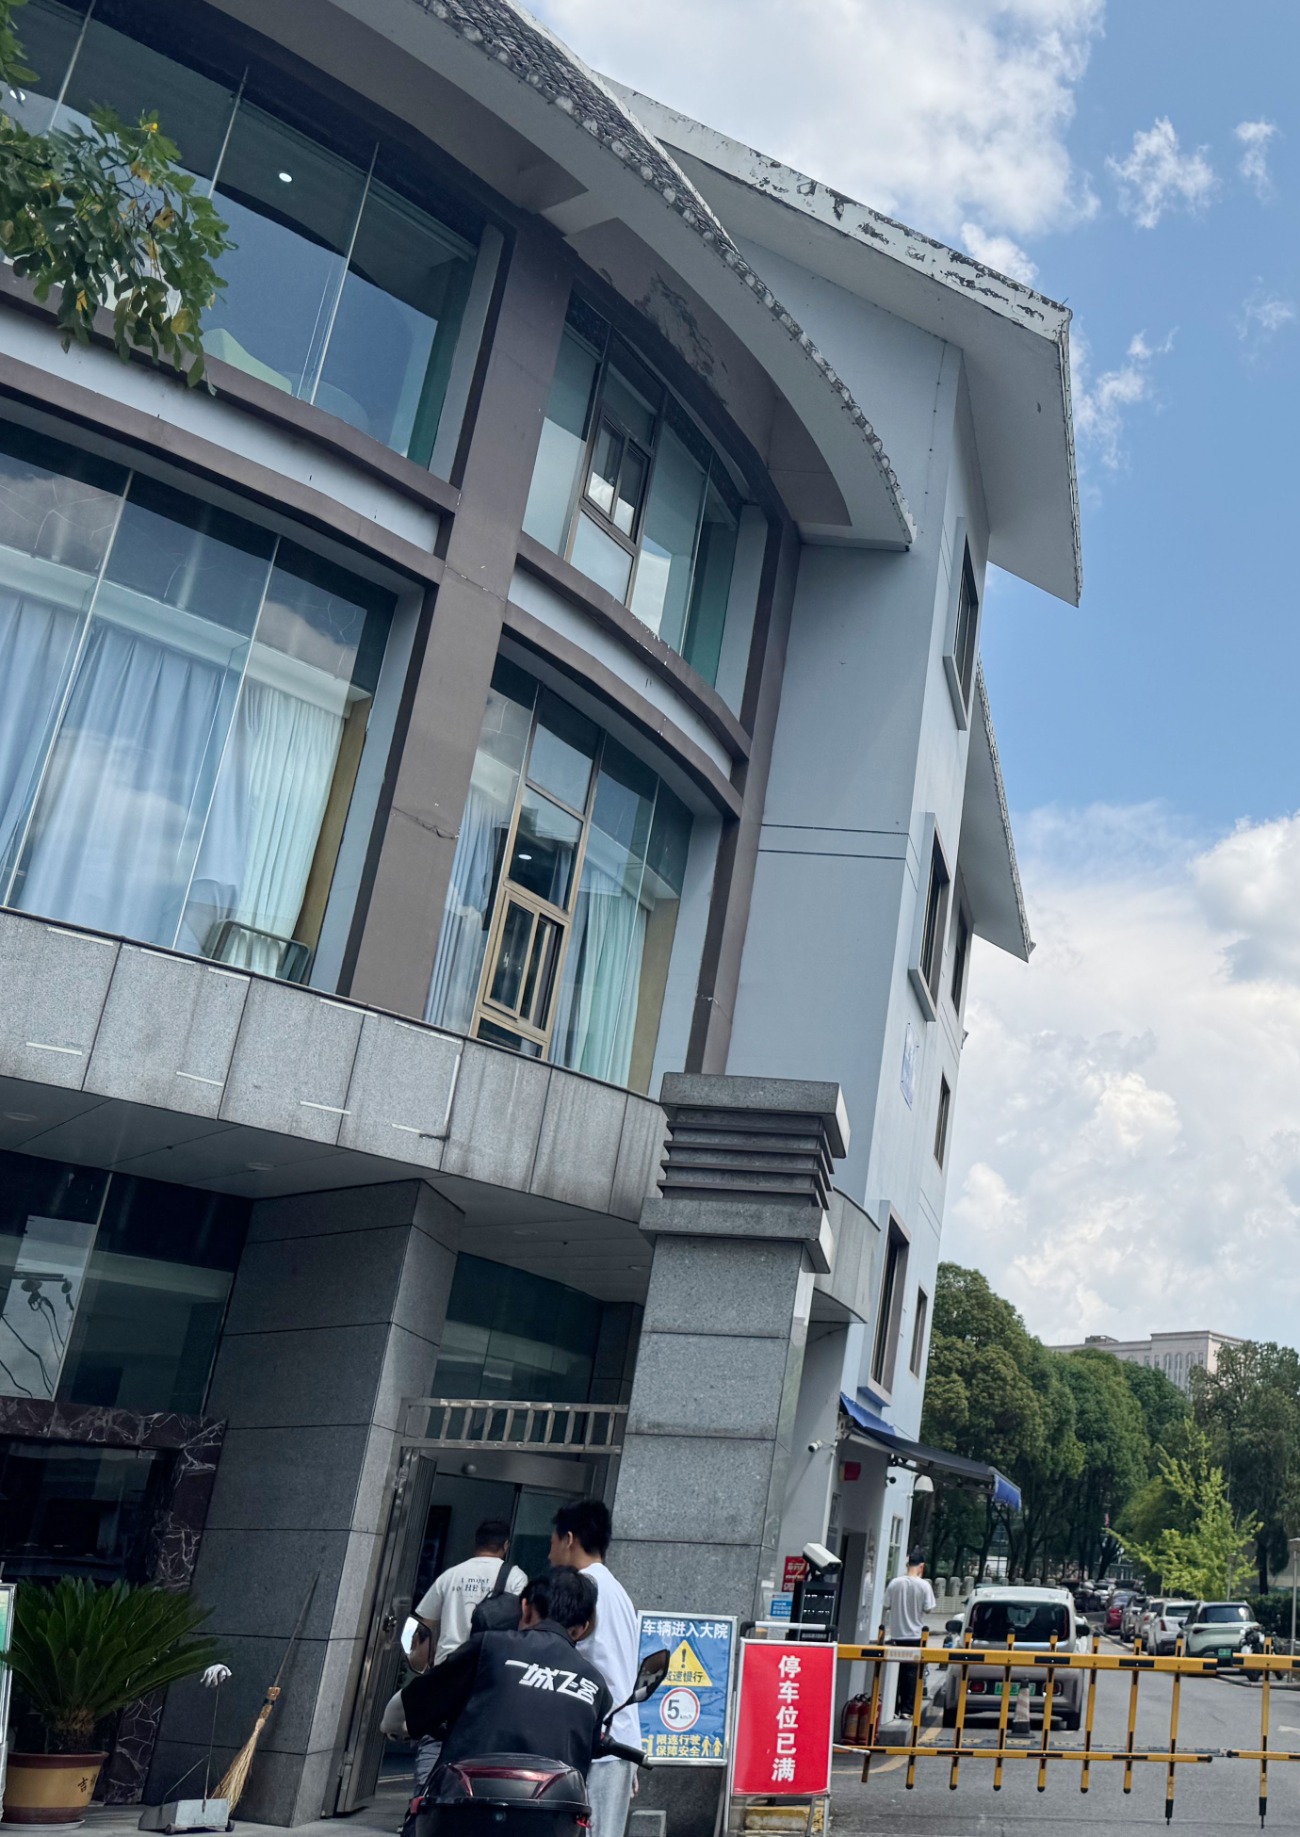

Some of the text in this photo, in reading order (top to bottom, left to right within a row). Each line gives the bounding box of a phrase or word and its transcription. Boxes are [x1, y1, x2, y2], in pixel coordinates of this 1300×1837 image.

[464, 1583, 479, 1592] HE
[642, 1619, 729, 1640] 车辆进入大院
[771, 1654, 802, 1783] 停车位已满
[656, 1734, 701, 1746] 限速行驶
[656, 1745, 701, 1757] 保障安全
